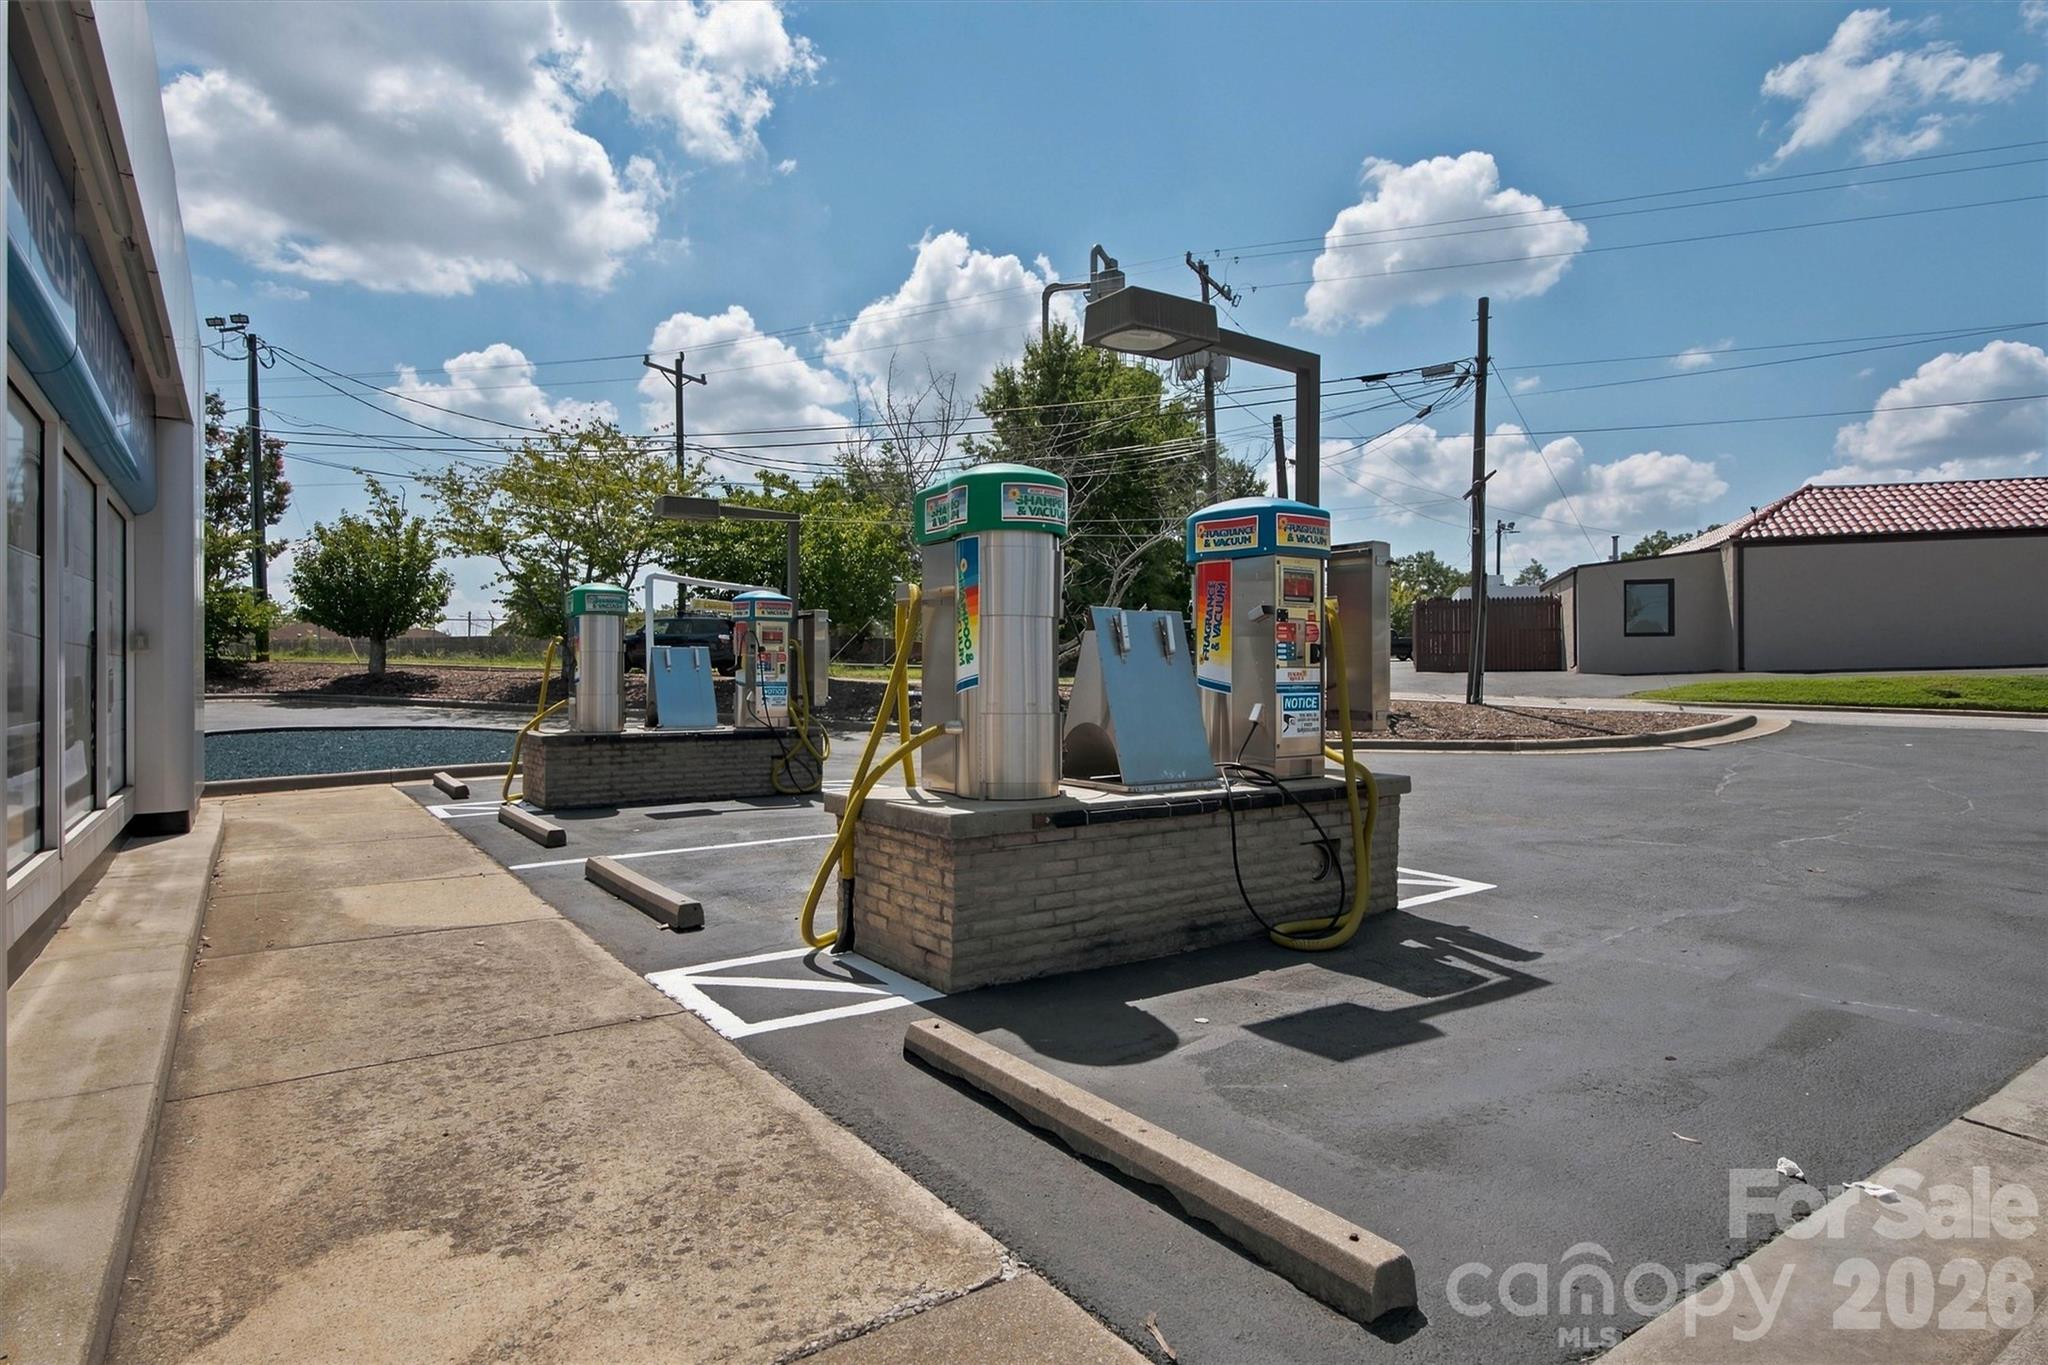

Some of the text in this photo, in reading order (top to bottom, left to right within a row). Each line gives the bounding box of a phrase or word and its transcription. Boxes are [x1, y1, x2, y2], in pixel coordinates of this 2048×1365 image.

[1017, 506, 1027, 516] &
[1204, 535, 1252, 547] & VACUUM
[1287, 533, 1328, 547] & VACUUM
[1203, 582, 1216, 661] FRAGRANCE
[1211, 582, 1226, 652] & VACUUM
[1284, 697, 1318, 709] NOTICE
